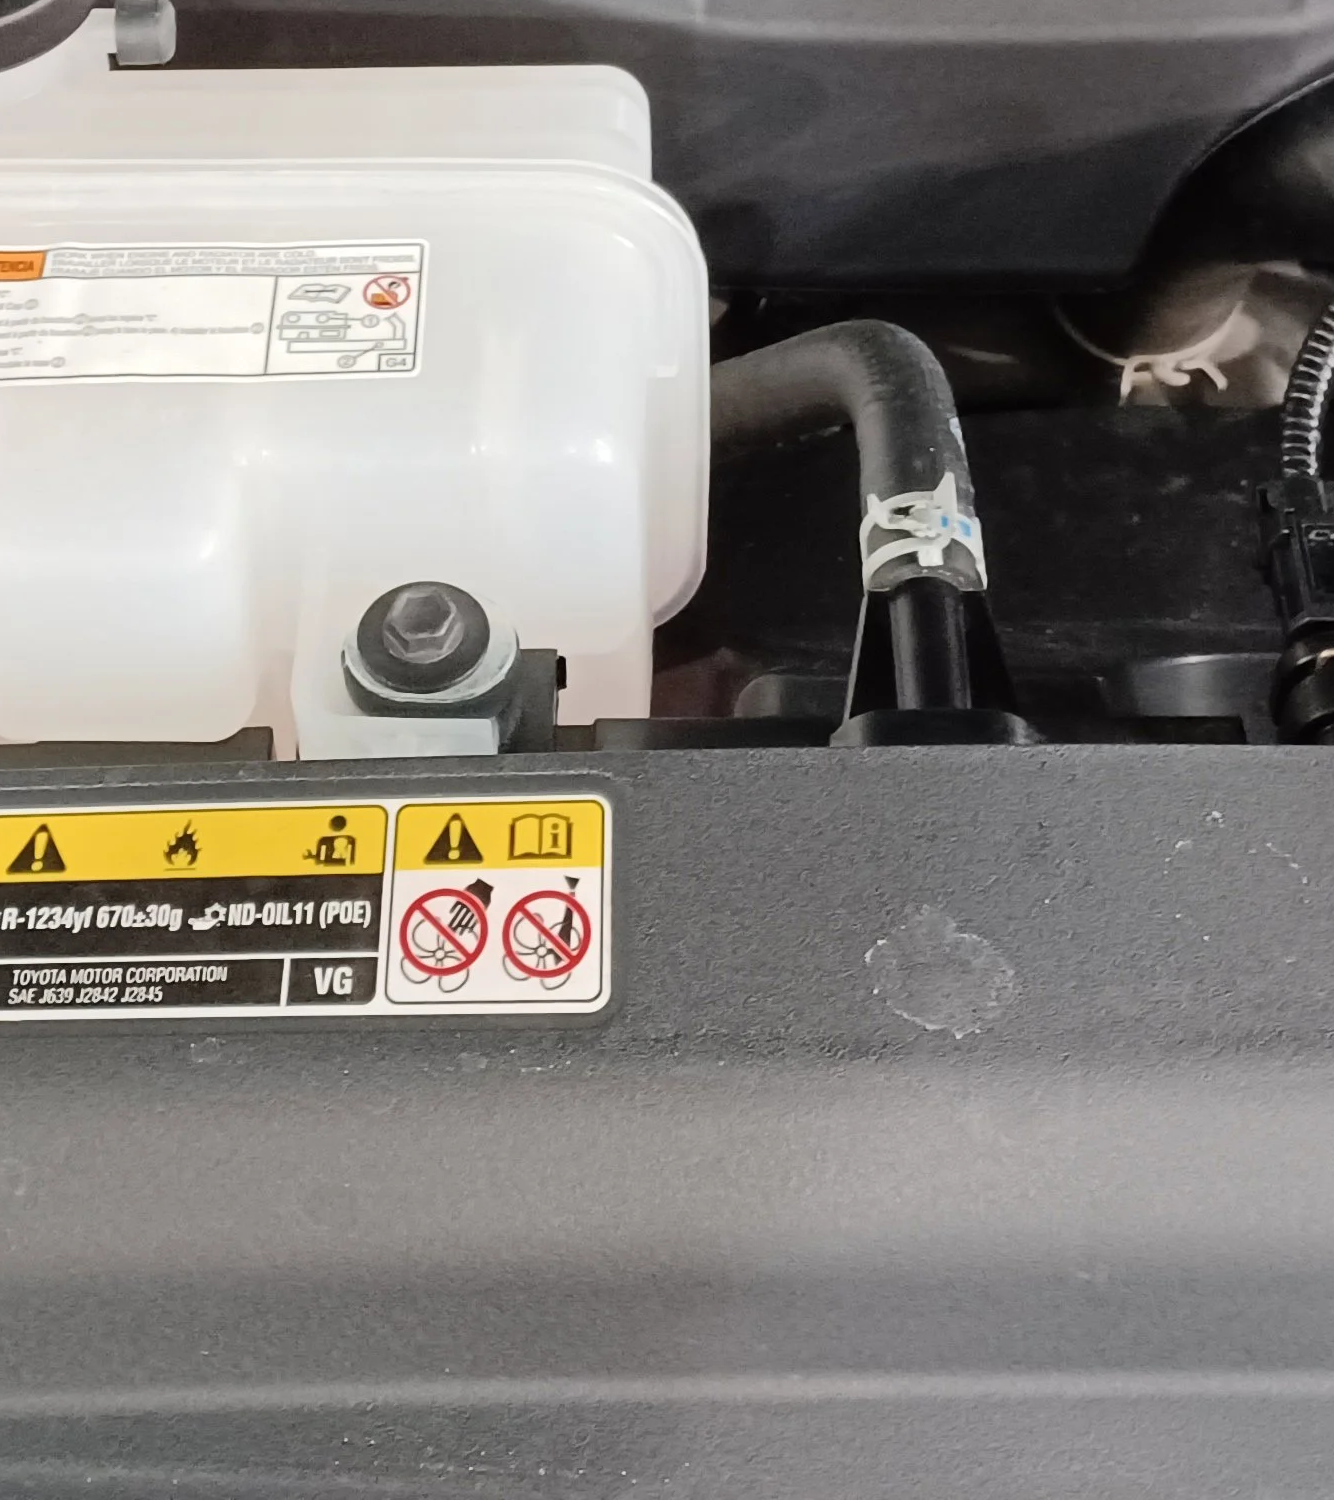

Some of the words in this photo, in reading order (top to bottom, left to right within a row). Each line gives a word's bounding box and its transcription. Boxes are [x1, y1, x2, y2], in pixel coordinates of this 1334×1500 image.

[385, 356, 407, 368] G4
[0, 905, 94, 934] R-1234yf
[96, 904, 183, 931] 670±30g
[227, 901, 315, 926] ND-OIL11
[319, 900, 372, 929] (POE)
[12, 968, 66, 985] TOYOTA
[70, 967, 123, 985] MOTOR
[125, 965, 228, 984] CORPORATION
[314, 966, 353, 995] VG
[8, 988, 36, 1005] SAE
[39, 986, 74, 1005] J639
[75, 986, 118, 1004] J2842
[121, 985, 163, 1003] J2845
